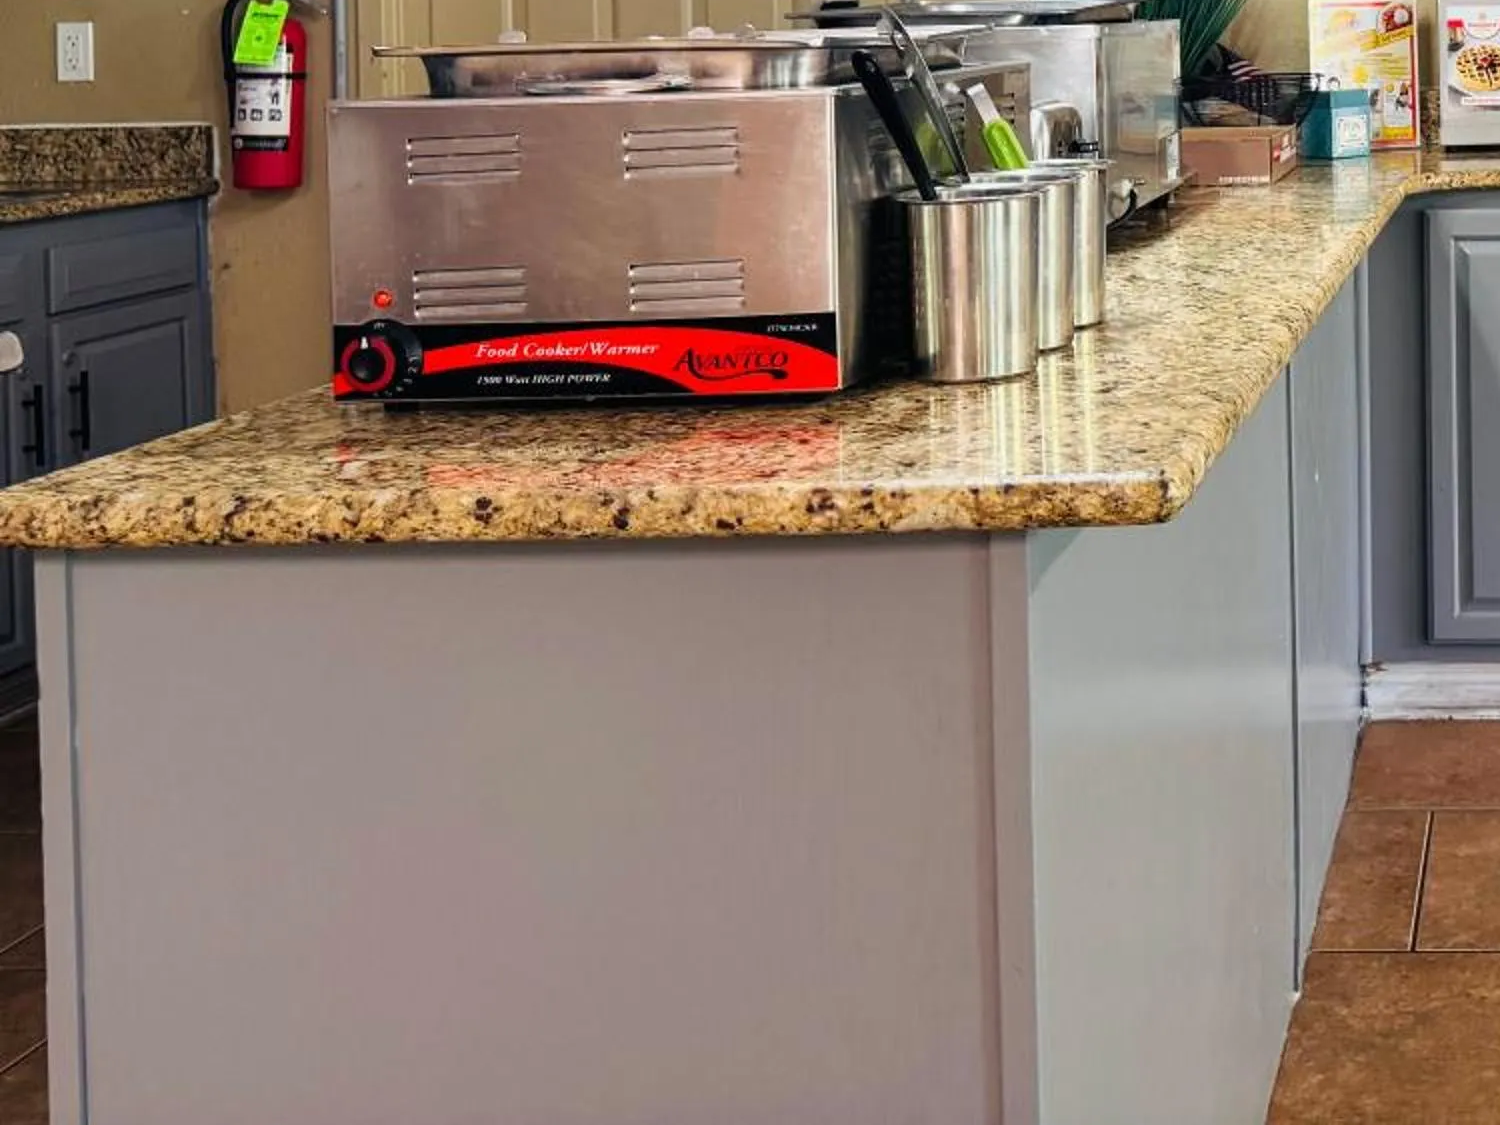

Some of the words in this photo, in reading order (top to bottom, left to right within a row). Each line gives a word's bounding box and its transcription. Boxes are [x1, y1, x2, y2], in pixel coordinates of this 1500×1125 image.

[475, 341, 519, 358] Food
[523, 340, 660, 357] Cooker/Warmer
[531, 374, 565, 384] HIGH
[567, 374, 611, 384] POWER
